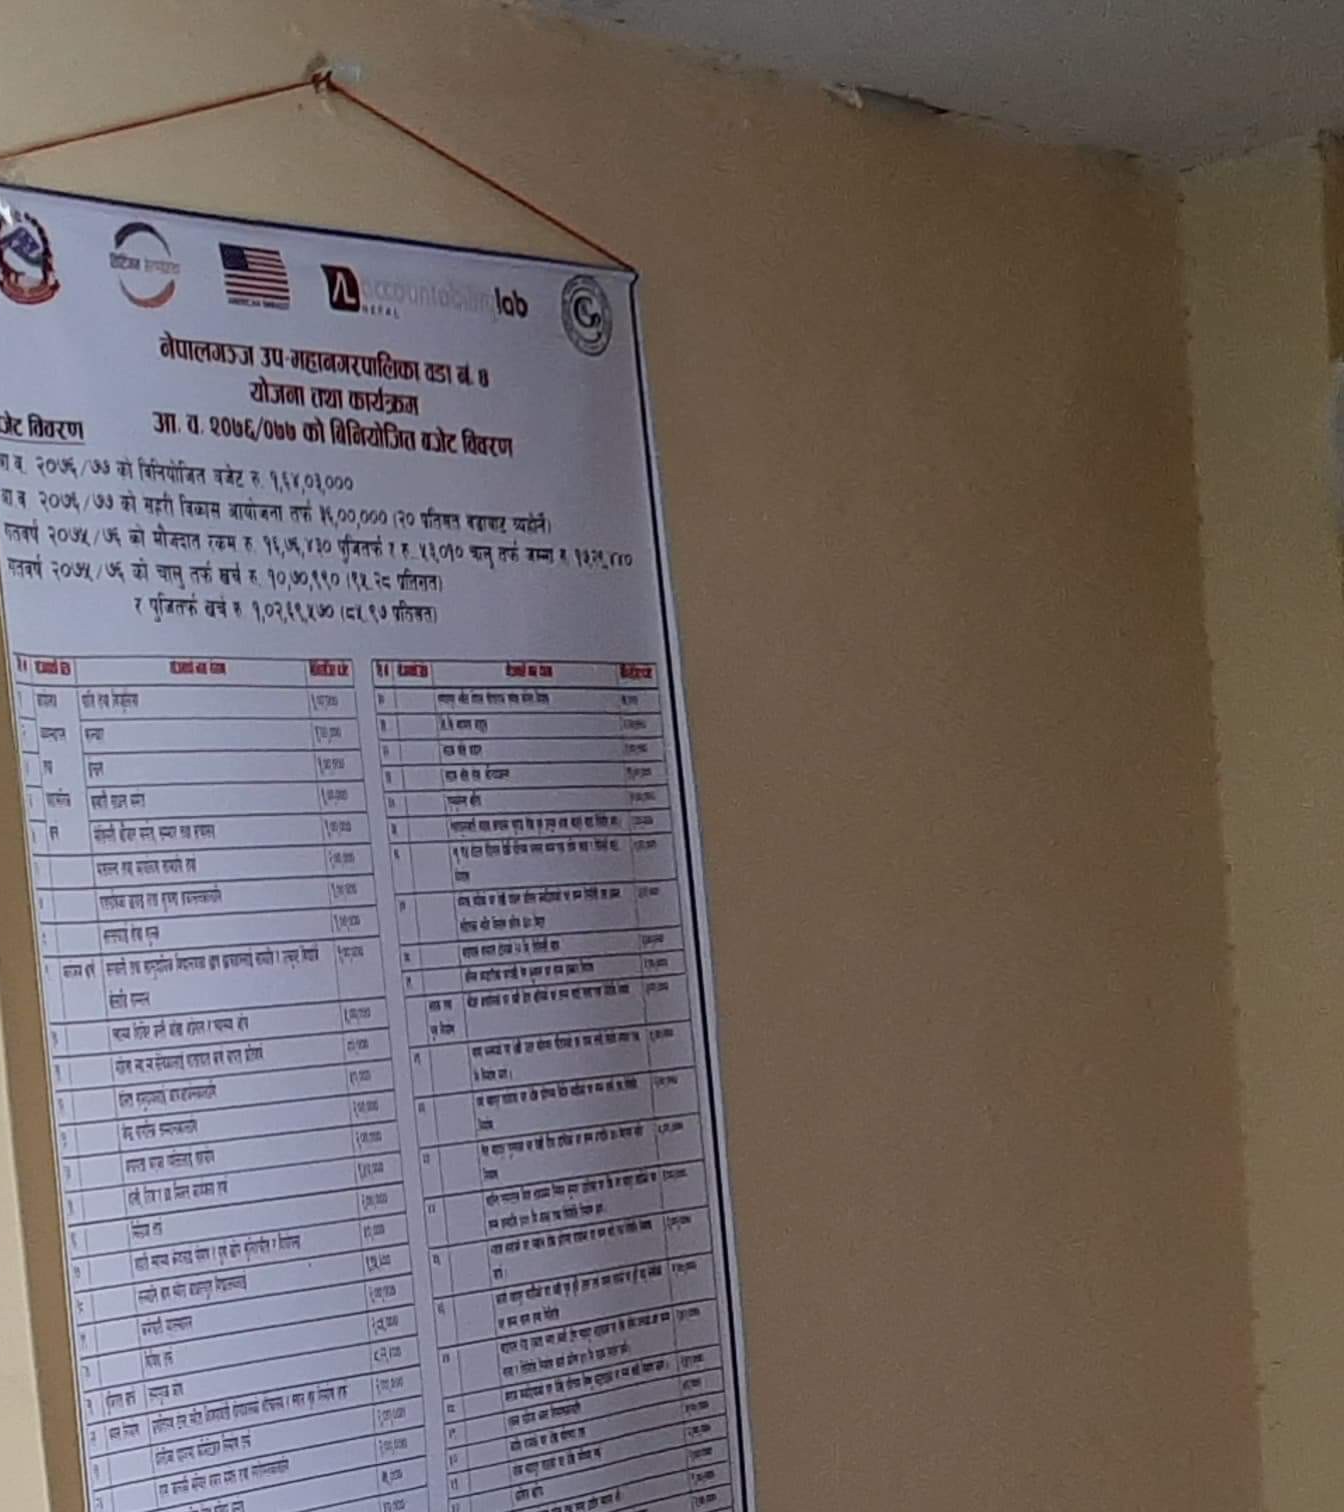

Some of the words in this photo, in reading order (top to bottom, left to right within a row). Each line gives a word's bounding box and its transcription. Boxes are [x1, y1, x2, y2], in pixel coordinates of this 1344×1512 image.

[425, 362, 452, 384] वडा
[249, 376, 305, 406] योजना
[311, 387, 343, 409] तथा
[348, 386, 420, 416] कार्यक्रम
[28, 412, 85, 440] विवरण
[209, 416, 297, 442] २०७६/०७७
[303, 416, 325, 444] को
[461, 427, 513, 458] विवरण
